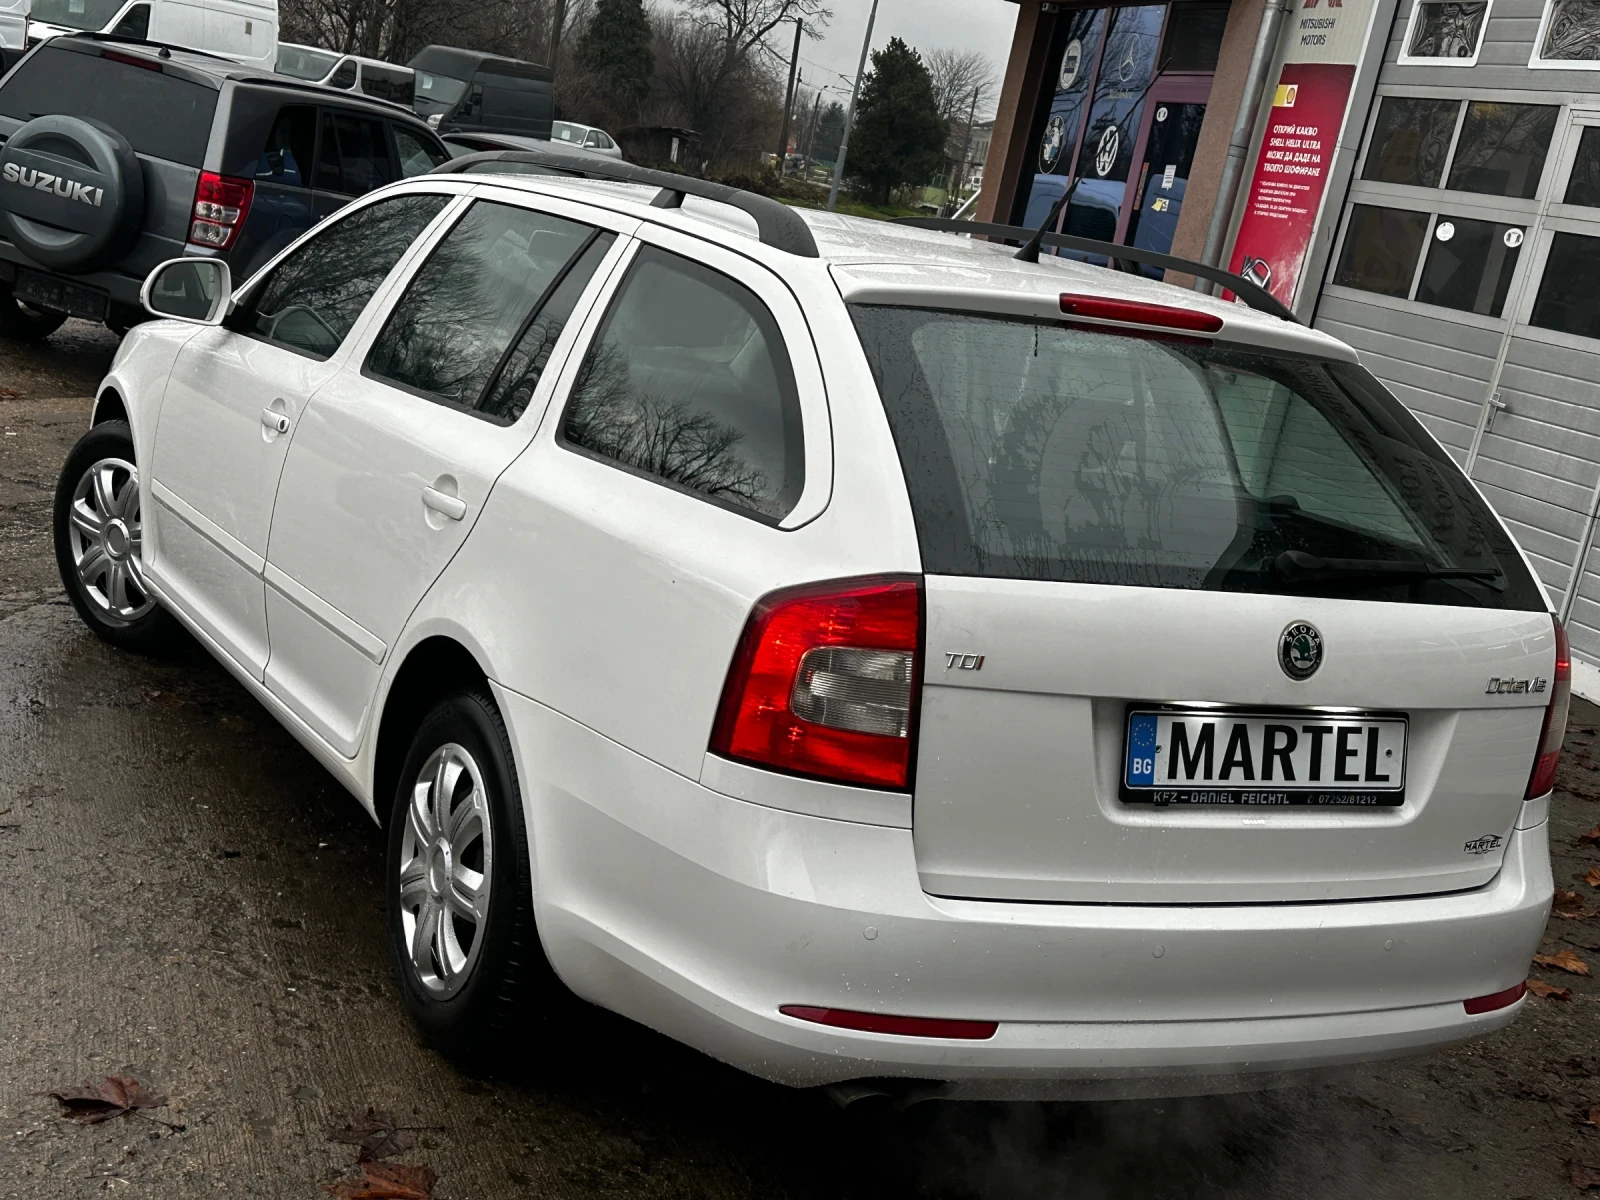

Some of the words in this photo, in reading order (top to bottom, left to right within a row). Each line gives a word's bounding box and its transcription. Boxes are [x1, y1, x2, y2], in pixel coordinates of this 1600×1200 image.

[1300, 18, 1336, 29] MITSUBISHI
[1300, 34, 1327, 45] MOTORS
[1273, 124, 1296, 135] ОТКРИЙ
[1296, 126, 1318, 136] КАКВО
[1269, 138, 1285, 147] SHELL
[1302, 140, 1321, 149] ULTRA
[1266, 150, 1285, 160] МОЖЕ
[1283, 152, 1293, 162] ДА
[1293, 153, 1311, 163] ДАДЕ
[1311, 154, 1321, 163] НА
[1263, 163, 1284, 173] ТВОЕТО
[2, 162, 104, 207] SUZUKI
[945, 651, 986, 671] TDI
[1167, 721, 1390, 783] MARTEL
[1132, 758, 1152, 775] BG
[1241, 793, 1290, 804] FEICHTL
[1464, 839, 1502, 851] MARTEL
